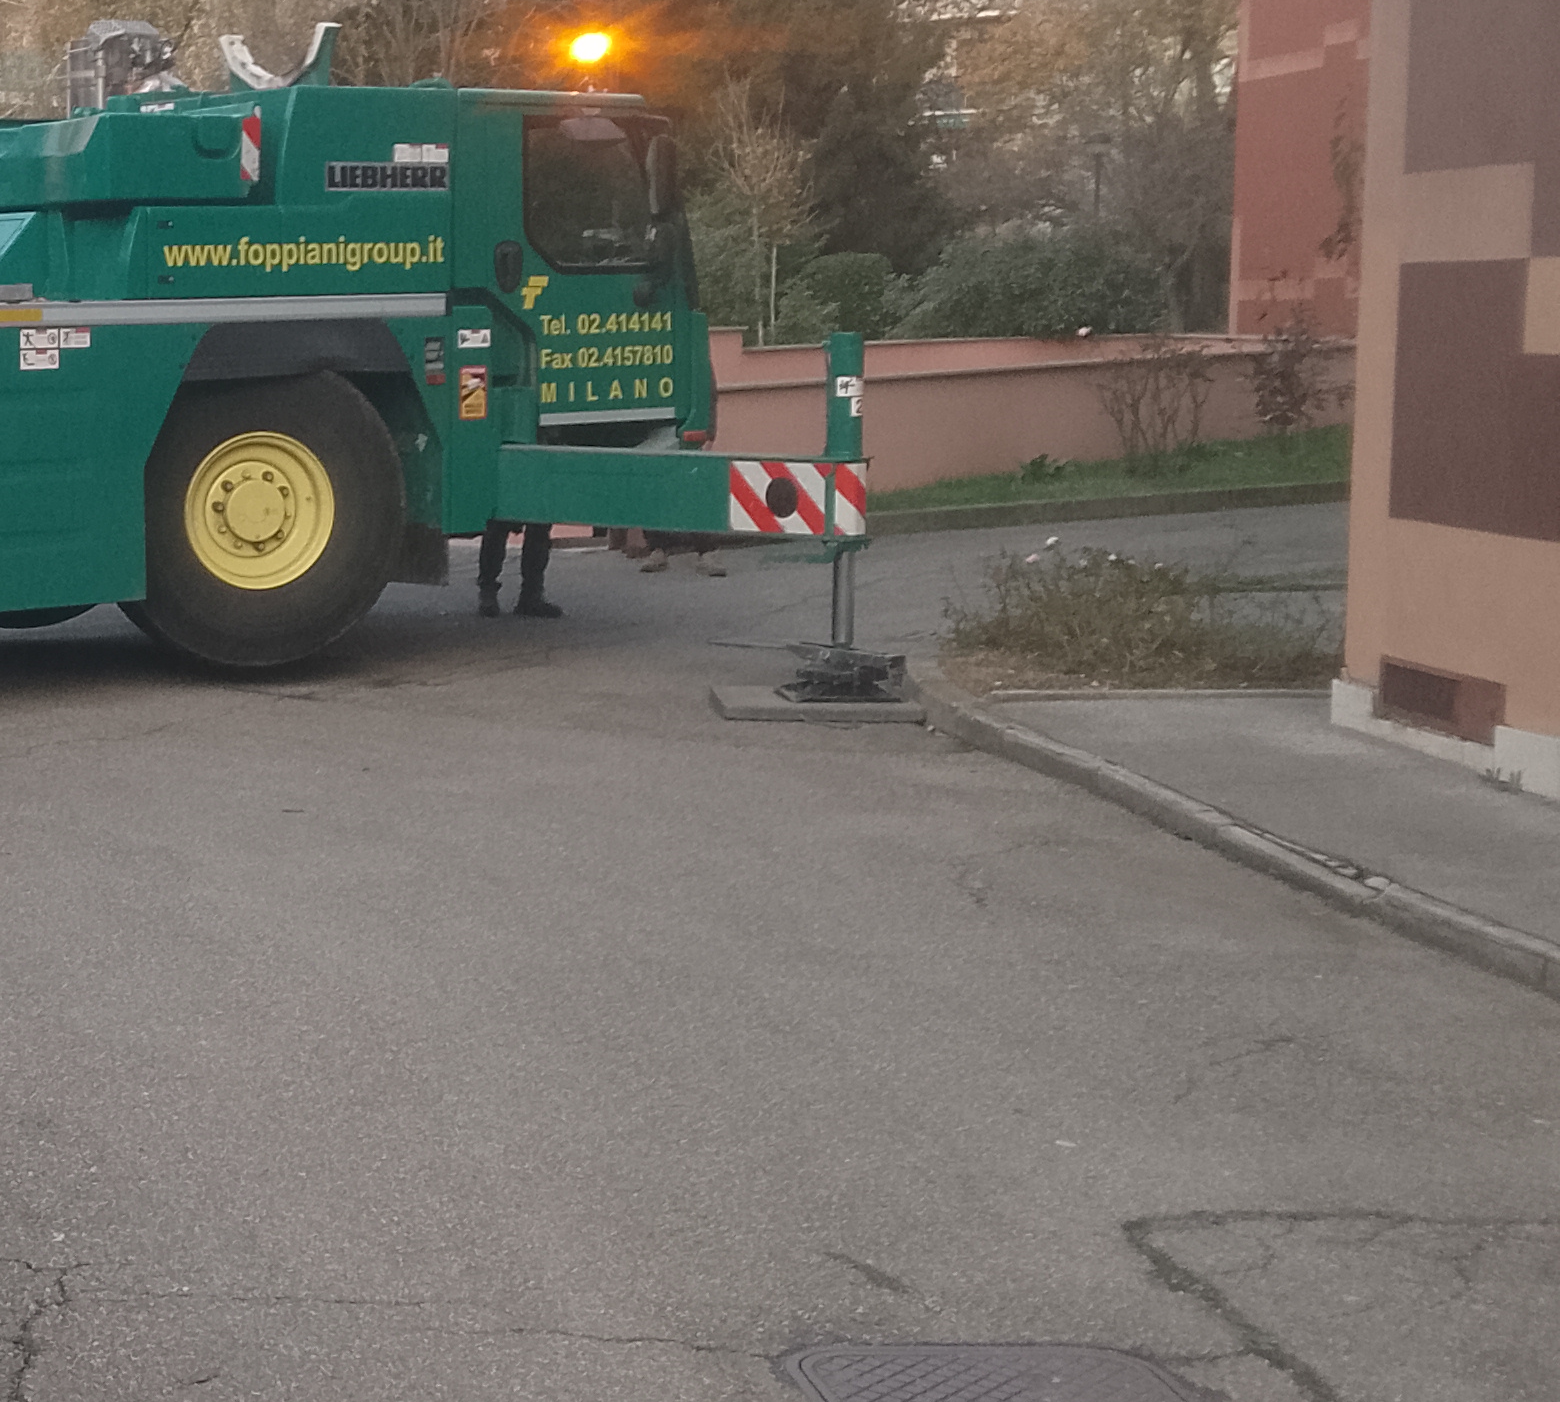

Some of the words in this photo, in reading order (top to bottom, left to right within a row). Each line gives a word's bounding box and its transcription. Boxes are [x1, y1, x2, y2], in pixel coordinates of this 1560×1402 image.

[326, 164, 448, 190] LIEBHERR
[163, 236, 445, 272] www.foppianigroup.it
[541, 313, 571, 335] Tel.
[576, 311, 673, 334] 02.414141
[541, 348, 573, 369] Fax
[576, 345, 674, 368] 02.4157810
[541, 377, 674, 403] MILANO
